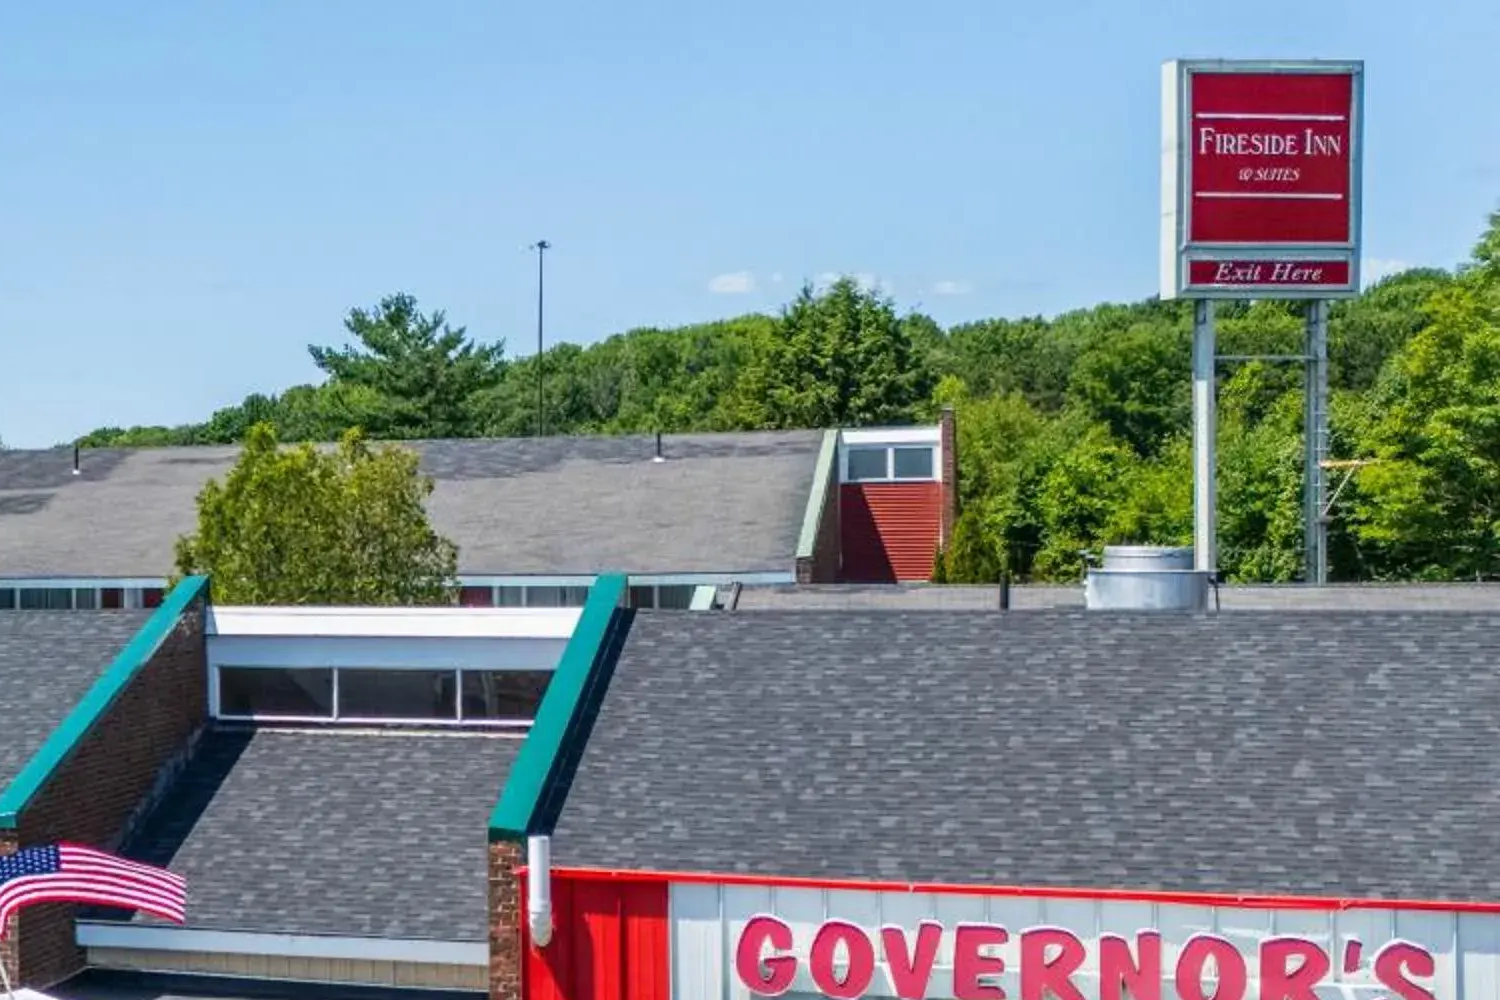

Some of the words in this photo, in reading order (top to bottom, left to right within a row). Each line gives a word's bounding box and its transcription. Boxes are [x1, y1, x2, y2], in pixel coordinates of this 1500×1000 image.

[1200, 127, 1298, 155] FIRESIDE
[1304, 128, 1341, 156] INN
[1255, 167, 1301, 181] SUITES
[1215, 263, 1261, 281] Exit
[1270, 263, 1322, 281] Here
